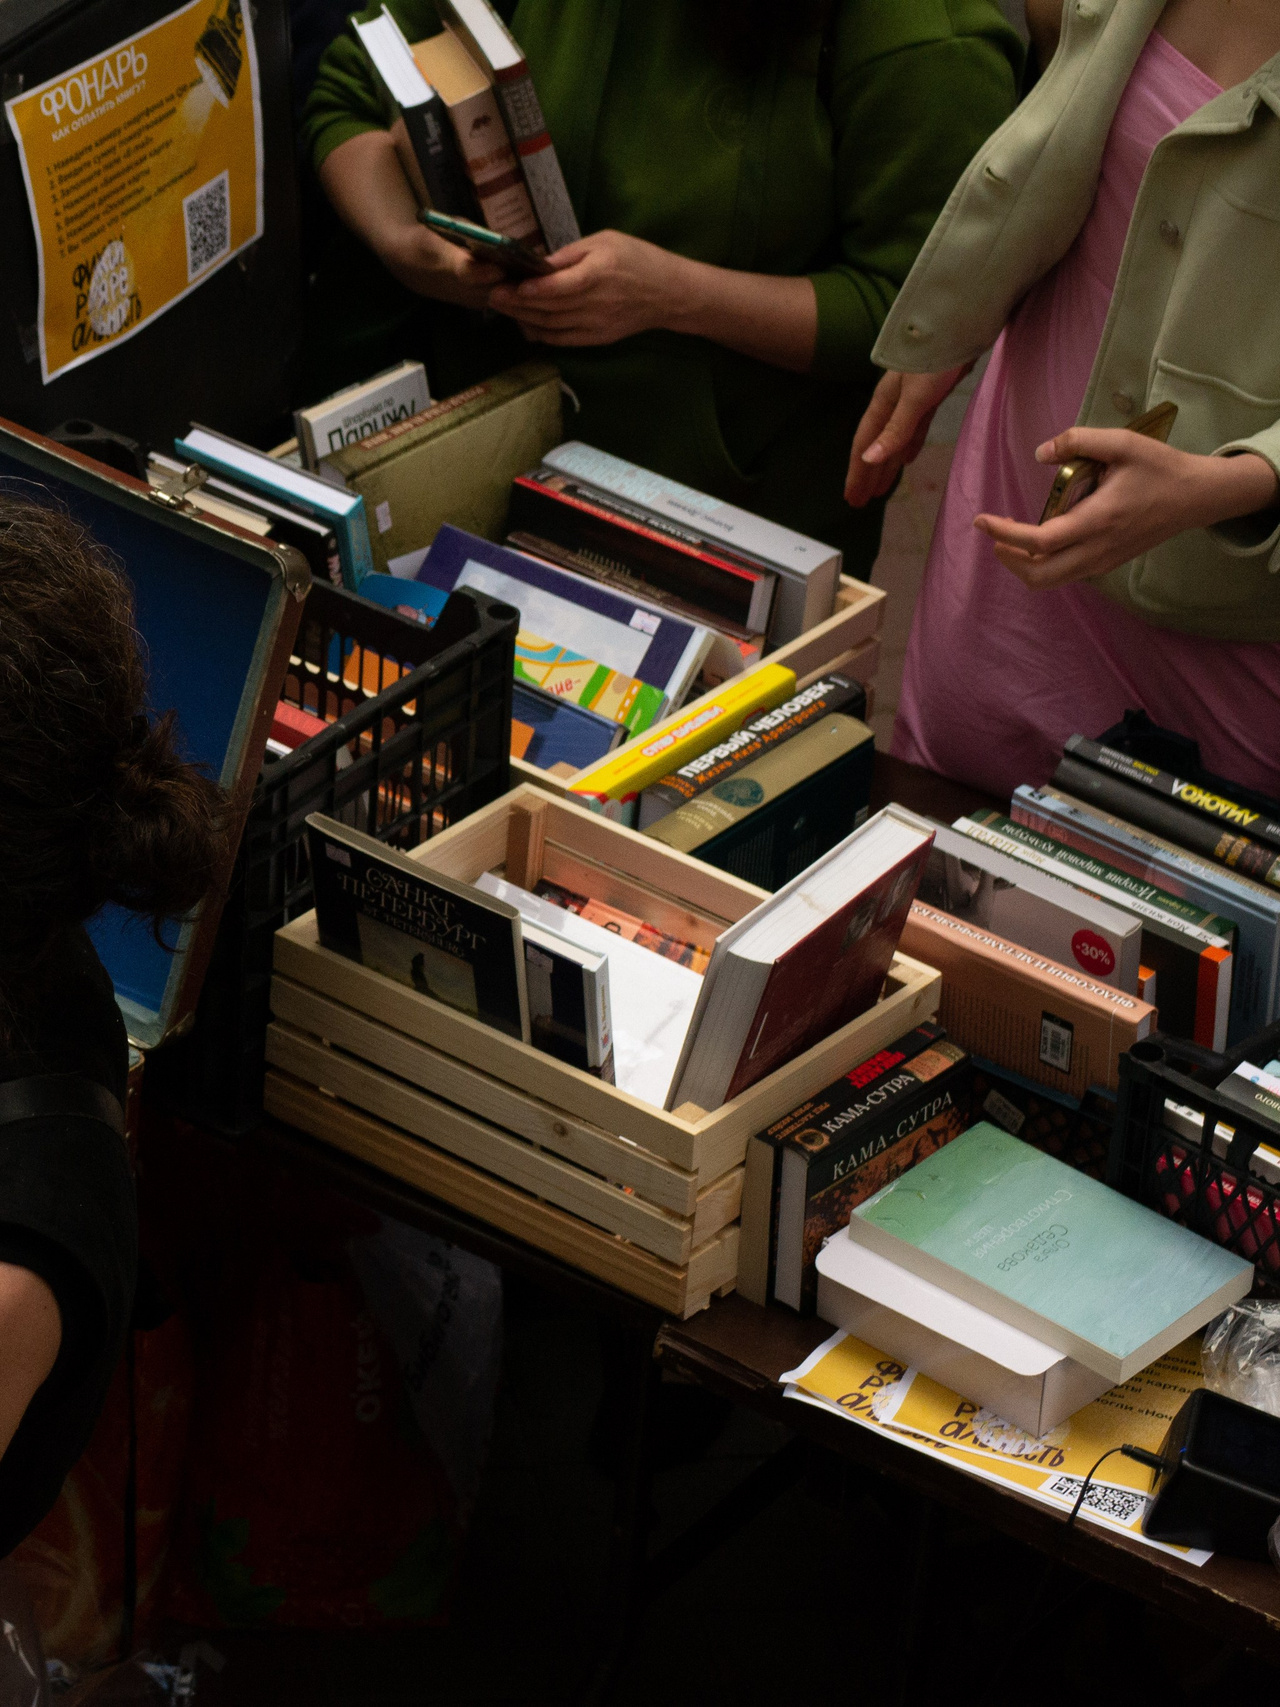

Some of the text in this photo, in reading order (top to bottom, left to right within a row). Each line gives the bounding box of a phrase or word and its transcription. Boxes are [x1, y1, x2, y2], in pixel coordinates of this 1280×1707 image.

[40, 46, 147, 120] ФОНАРЬ
[677, 728, 756, 777] ПЕРВЫЙ
[748, 680, 836, 732] ЧЕЛОВЕК
[694, 758, 733, 784] Жизнь
[731, 739, 762, 761] Нила
[1000, 820, 1157, 899] История мировой культуры
[337, 871, 488, 951] ПЕТЕРБУРГ
[927, 910, 1136, 1008] ФИЛОСОФИЯ И МЕТАМОРФОЗЫ
[1073, 943, 1111, 968] -30%
[821, 1072, 915, 1133] КАМА-СУТРА
[833, 1091, 953, 1181] КАМА-СУТРА
[972, 1190, 1073, 1259] Стихотворения
[996, 1225, 1068, 1272] Седакова
[1033, 1236, 1070, 1262] Ольга
